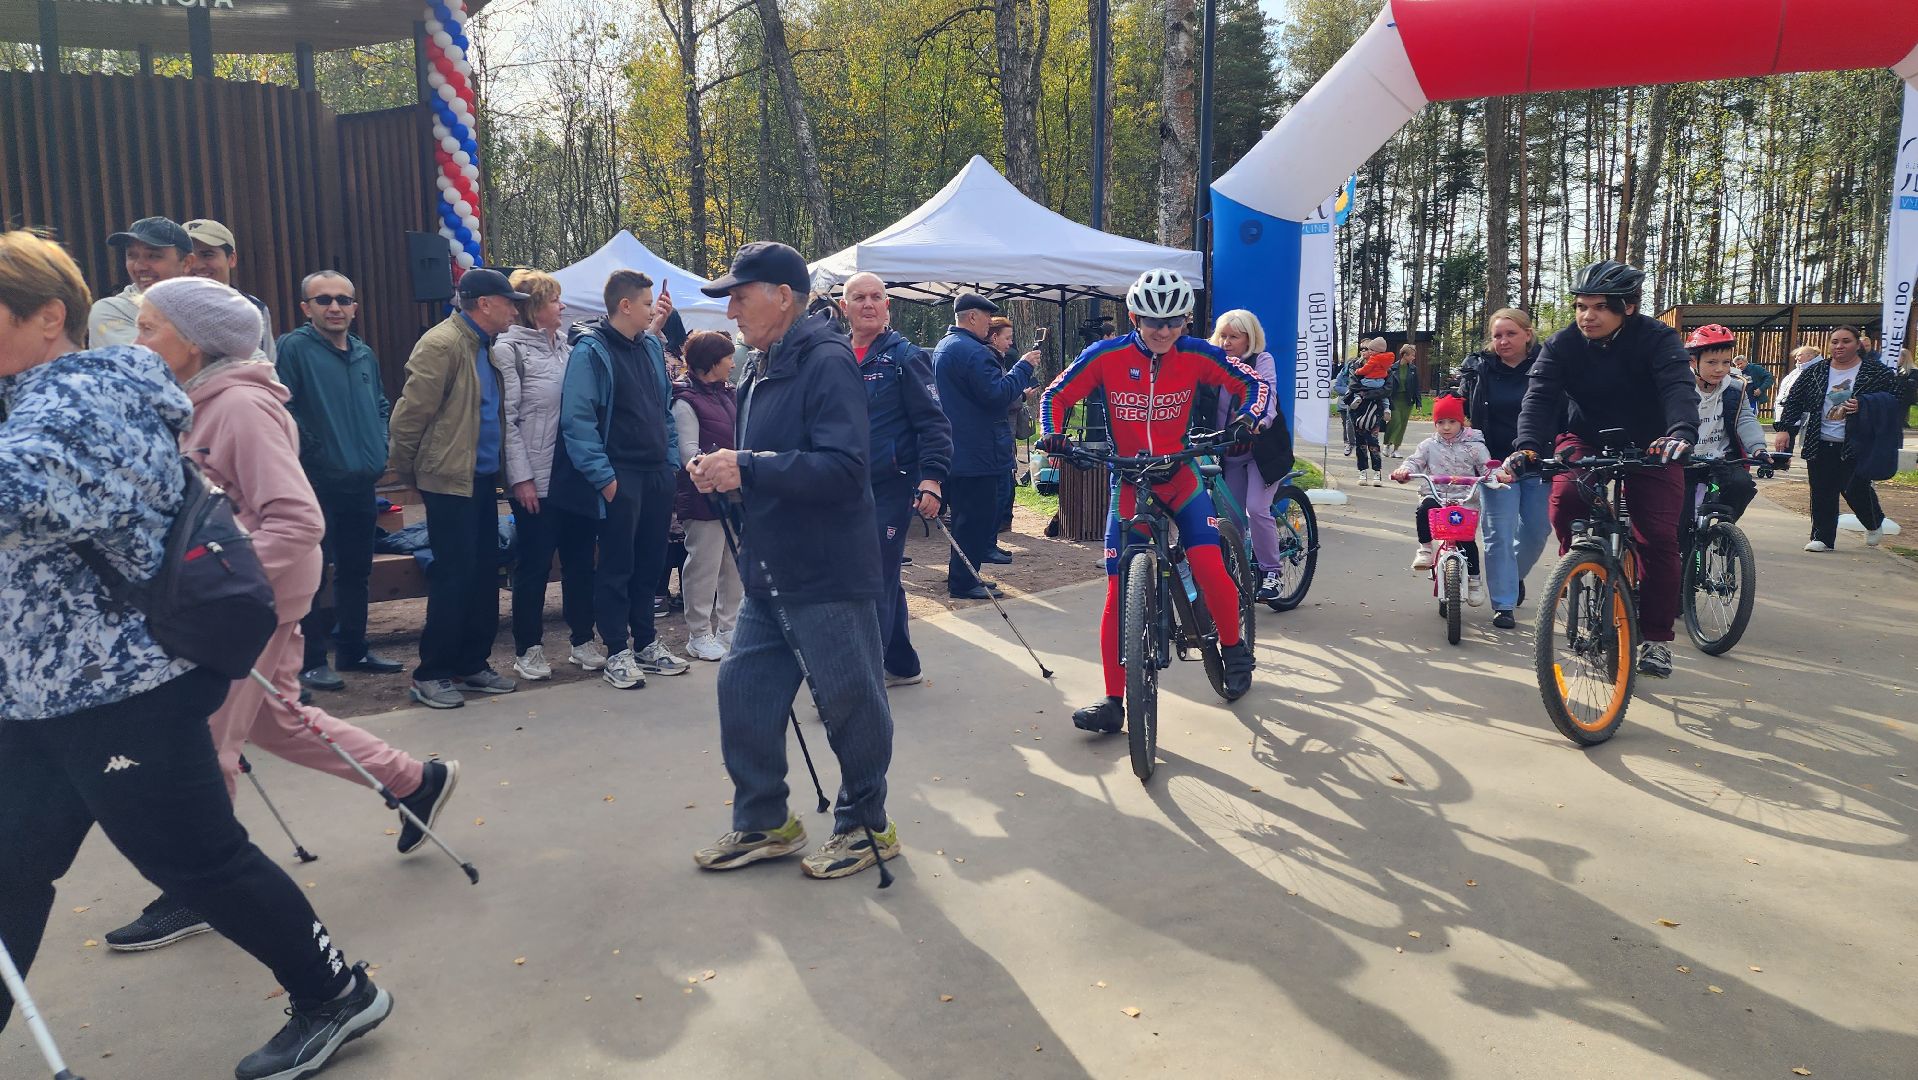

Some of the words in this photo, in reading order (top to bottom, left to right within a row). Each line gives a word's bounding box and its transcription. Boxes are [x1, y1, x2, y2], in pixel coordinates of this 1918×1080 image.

[1309, 292, 1331, 399] СООБЩЕСТВО
[1110, 389, 1192, 407] MOSCOW
[1115, 405, 1181, 421] REGION
